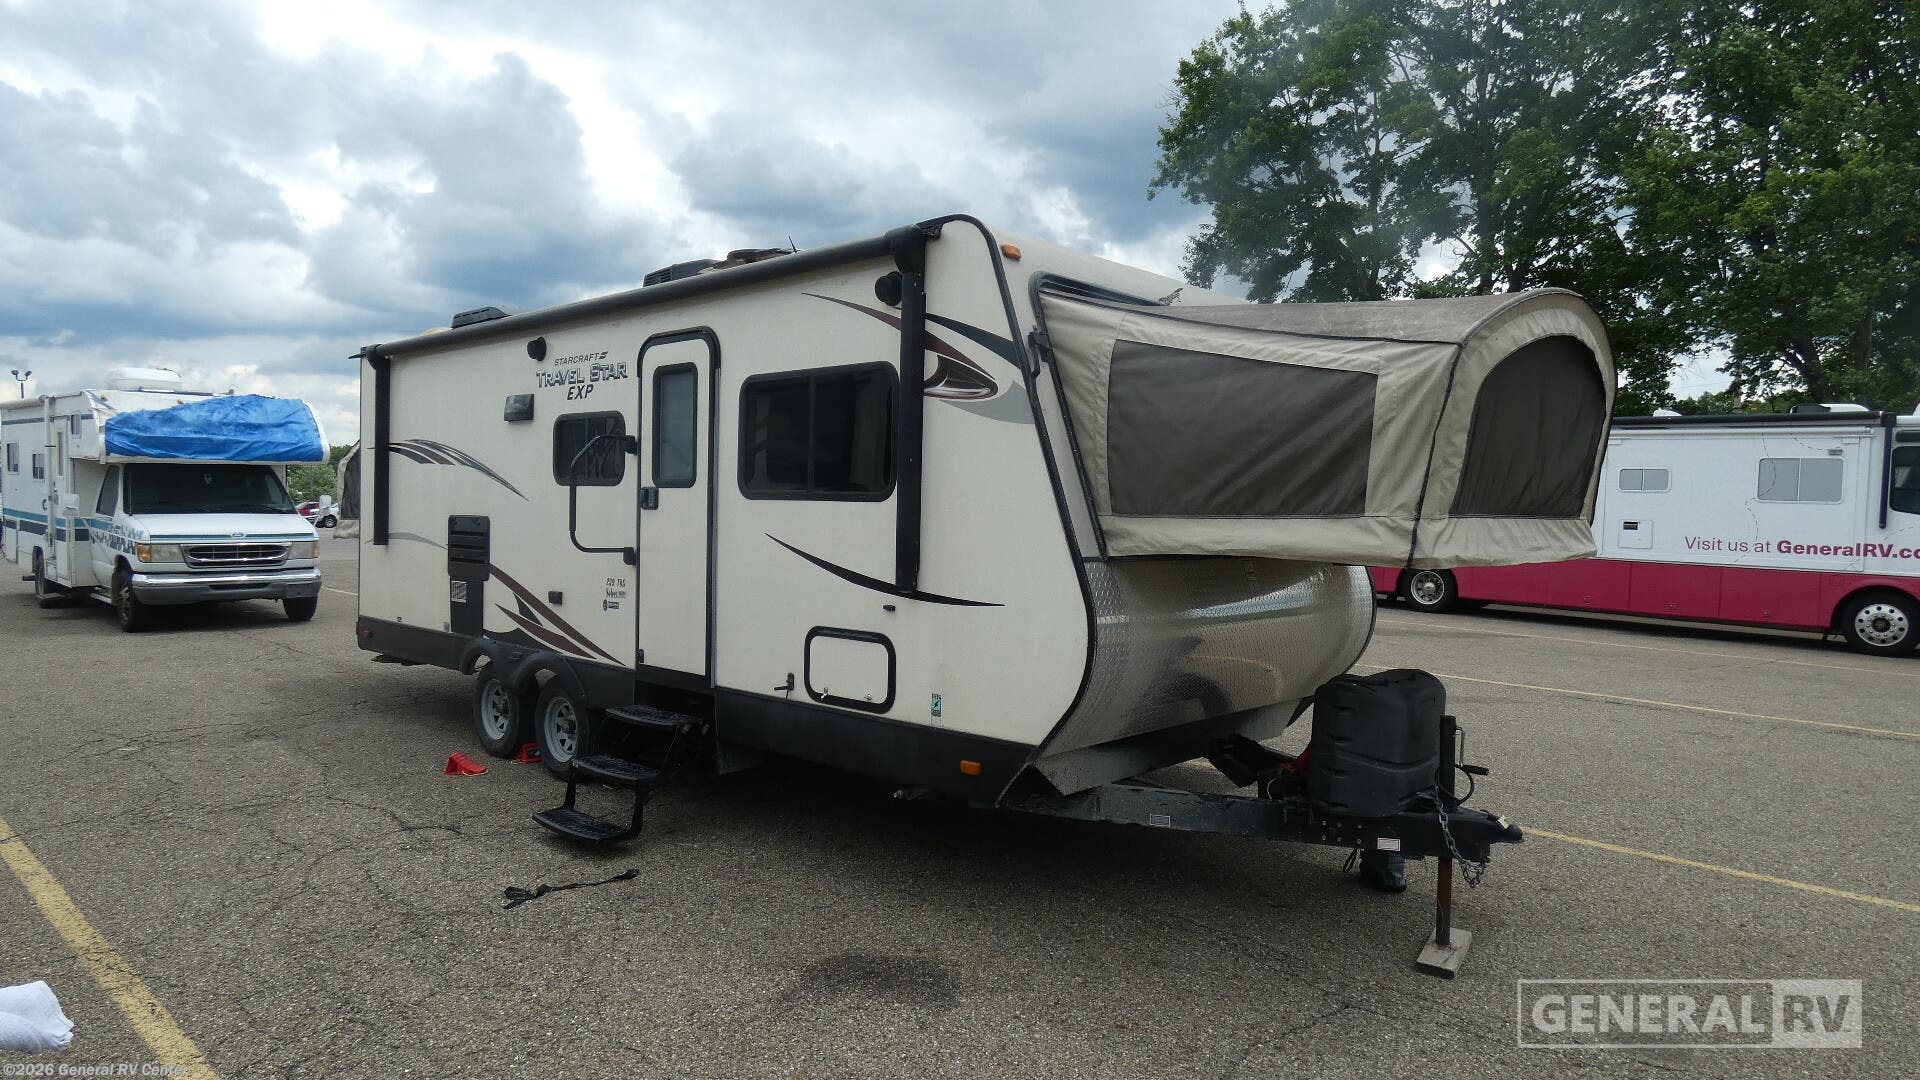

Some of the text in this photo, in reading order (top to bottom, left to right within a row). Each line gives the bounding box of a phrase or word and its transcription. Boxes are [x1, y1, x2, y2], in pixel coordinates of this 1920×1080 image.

[554, 352, 600, 366] STARCRAFT
[536, 361, 628, 388] TRAVEL STAR
[567, 384, 594, 400] EXP
[1685, 536, 1723, 551] Visit
[1728, 540, 1748, 552] us
[1754, 540, 1772, 553] at
